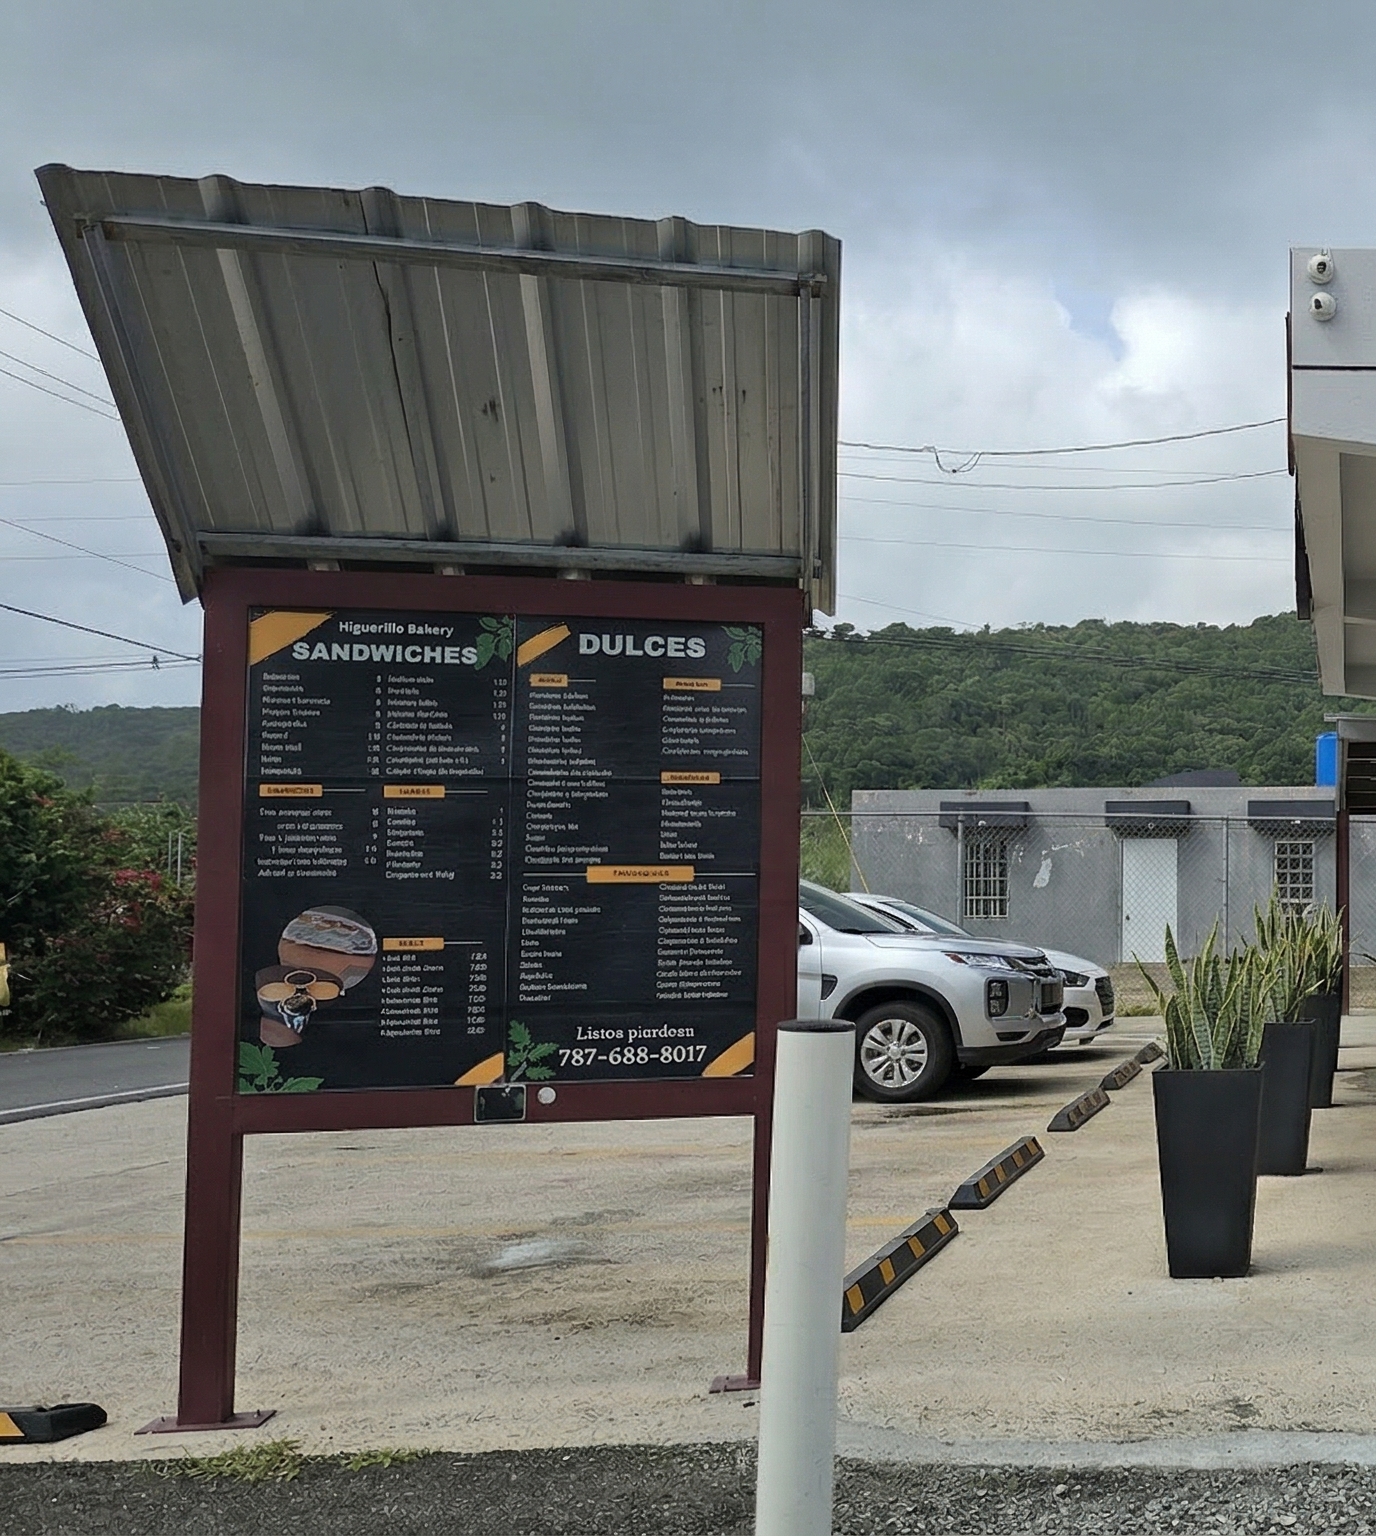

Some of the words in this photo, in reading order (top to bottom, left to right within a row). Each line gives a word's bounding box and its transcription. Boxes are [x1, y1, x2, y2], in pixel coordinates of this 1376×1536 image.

[339, 621, 404, 635] Higuerillo
[407, 623, 454, 638] Bakery
[291, 641, 478, 665] SANDWICHES
[579, 633, 706, 658] DULCES
[576, 1026, 624, 1041] Listos
[558, 1045, 708, 1067] 787-688-8017
